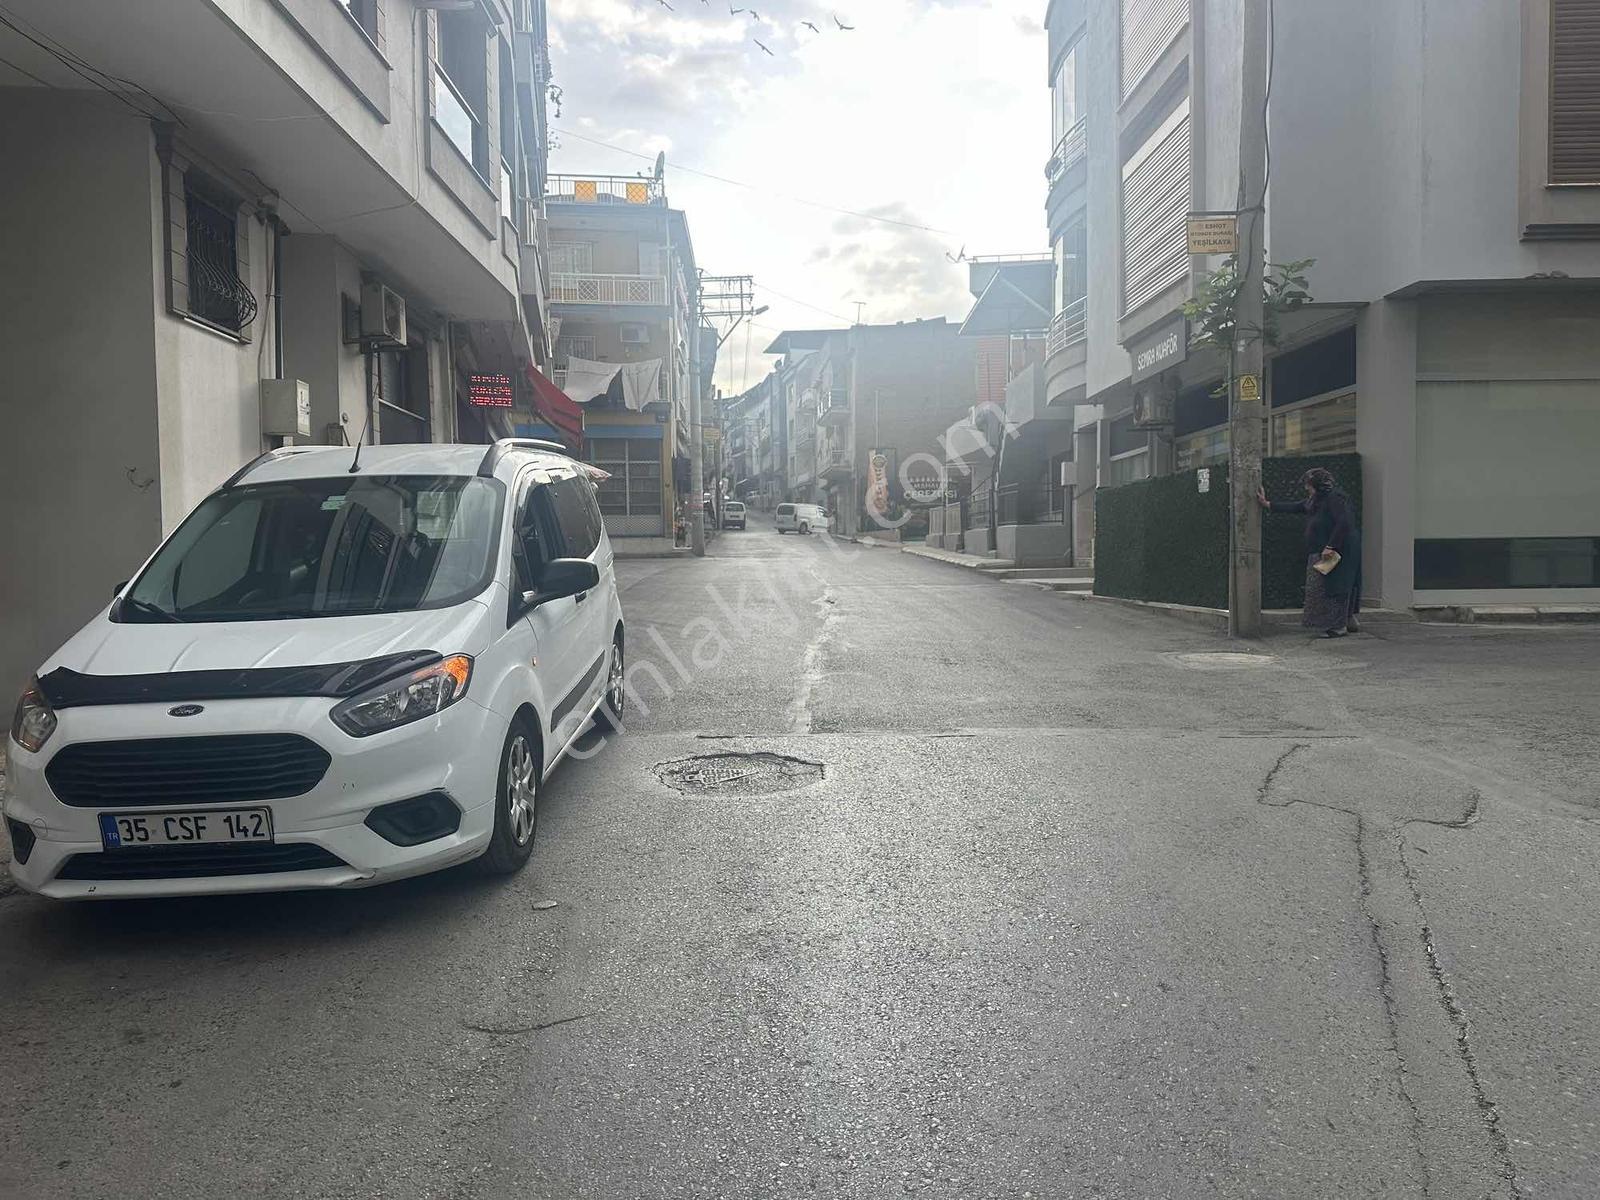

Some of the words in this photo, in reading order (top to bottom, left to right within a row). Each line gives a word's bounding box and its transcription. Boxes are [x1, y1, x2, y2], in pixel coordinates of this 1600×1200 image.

[1155, 332, 1178, 362] KUAFÖR
[108, 832, 119, 841] TR
[118, 818, 150, 842] 35
[163, 816, 207, 841] CSF
[223, 813, 265, 839] 142
